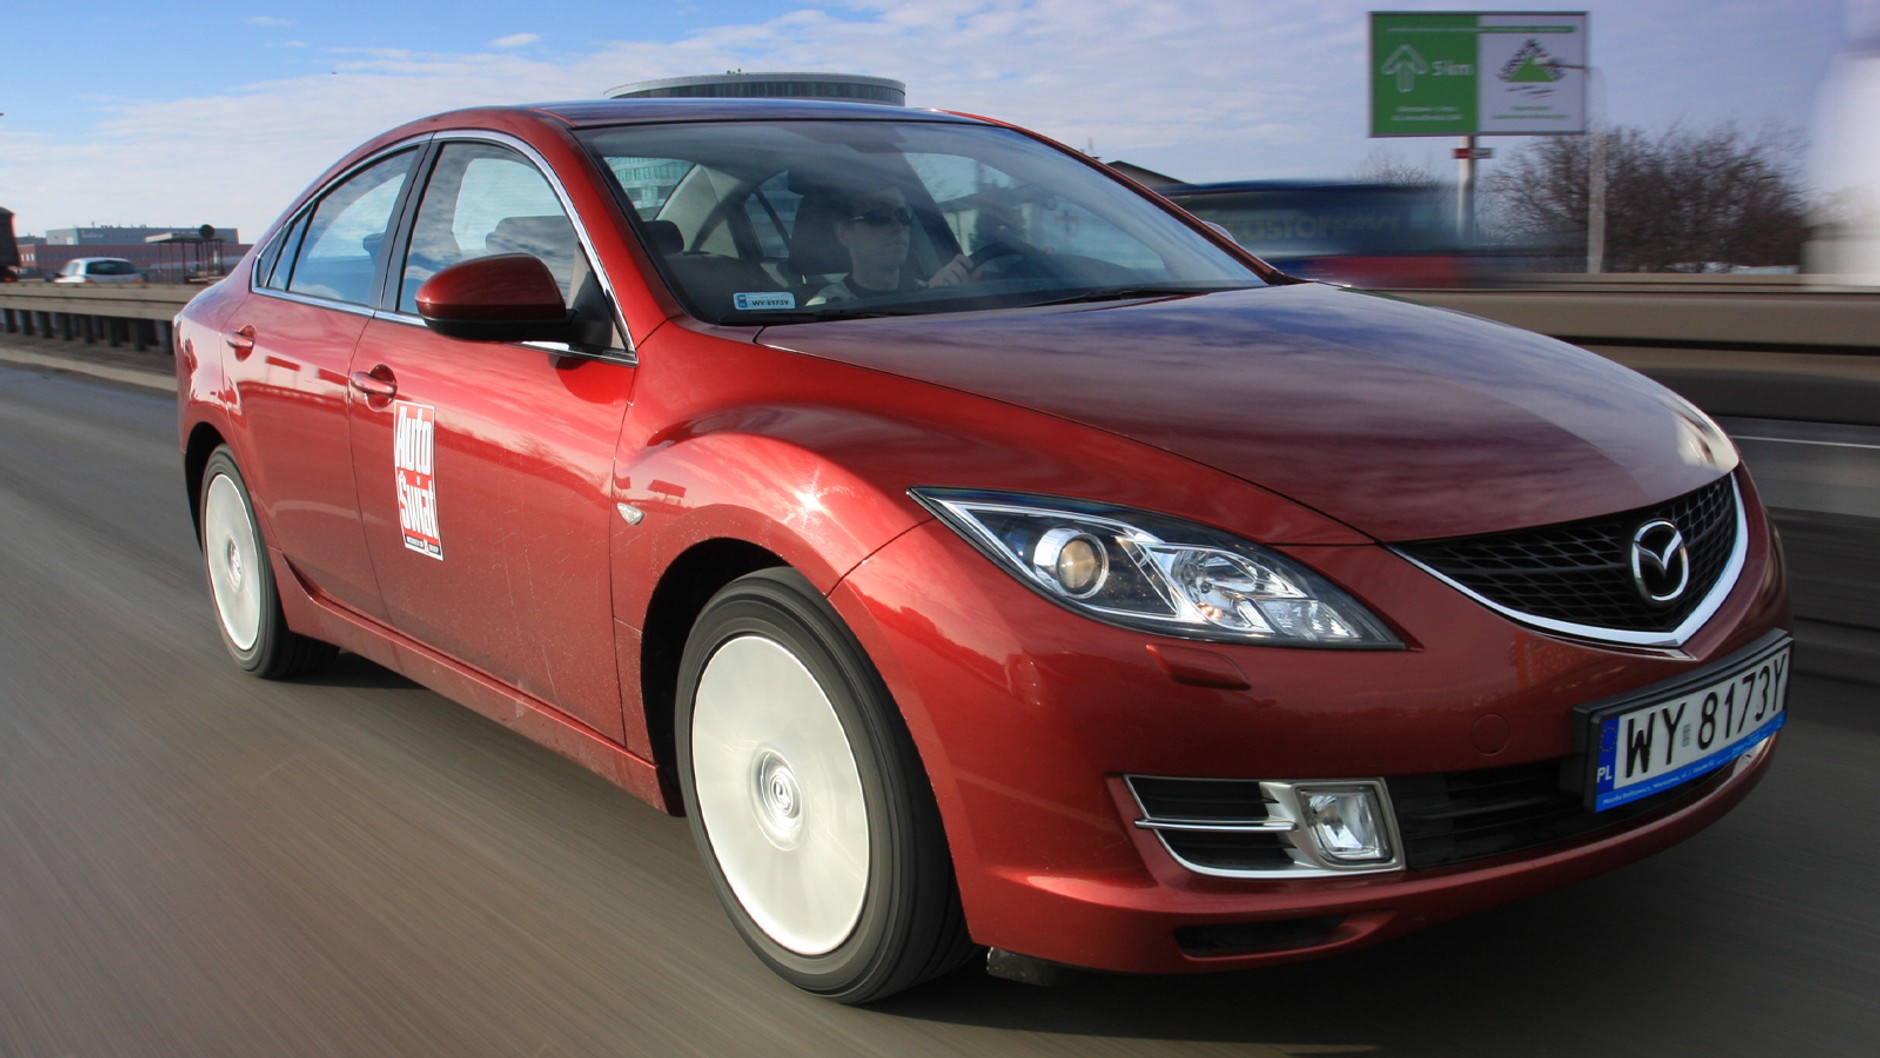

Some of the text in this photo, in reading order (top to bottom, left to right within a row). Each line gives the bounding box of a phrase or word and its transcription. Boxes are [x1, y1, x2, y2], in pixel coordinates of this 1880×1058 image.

[396, 406, 432, 476] Auto
[1626, 653, 1787, 779] WY 8173Y
[1597, 765, 1613, 783] PL
